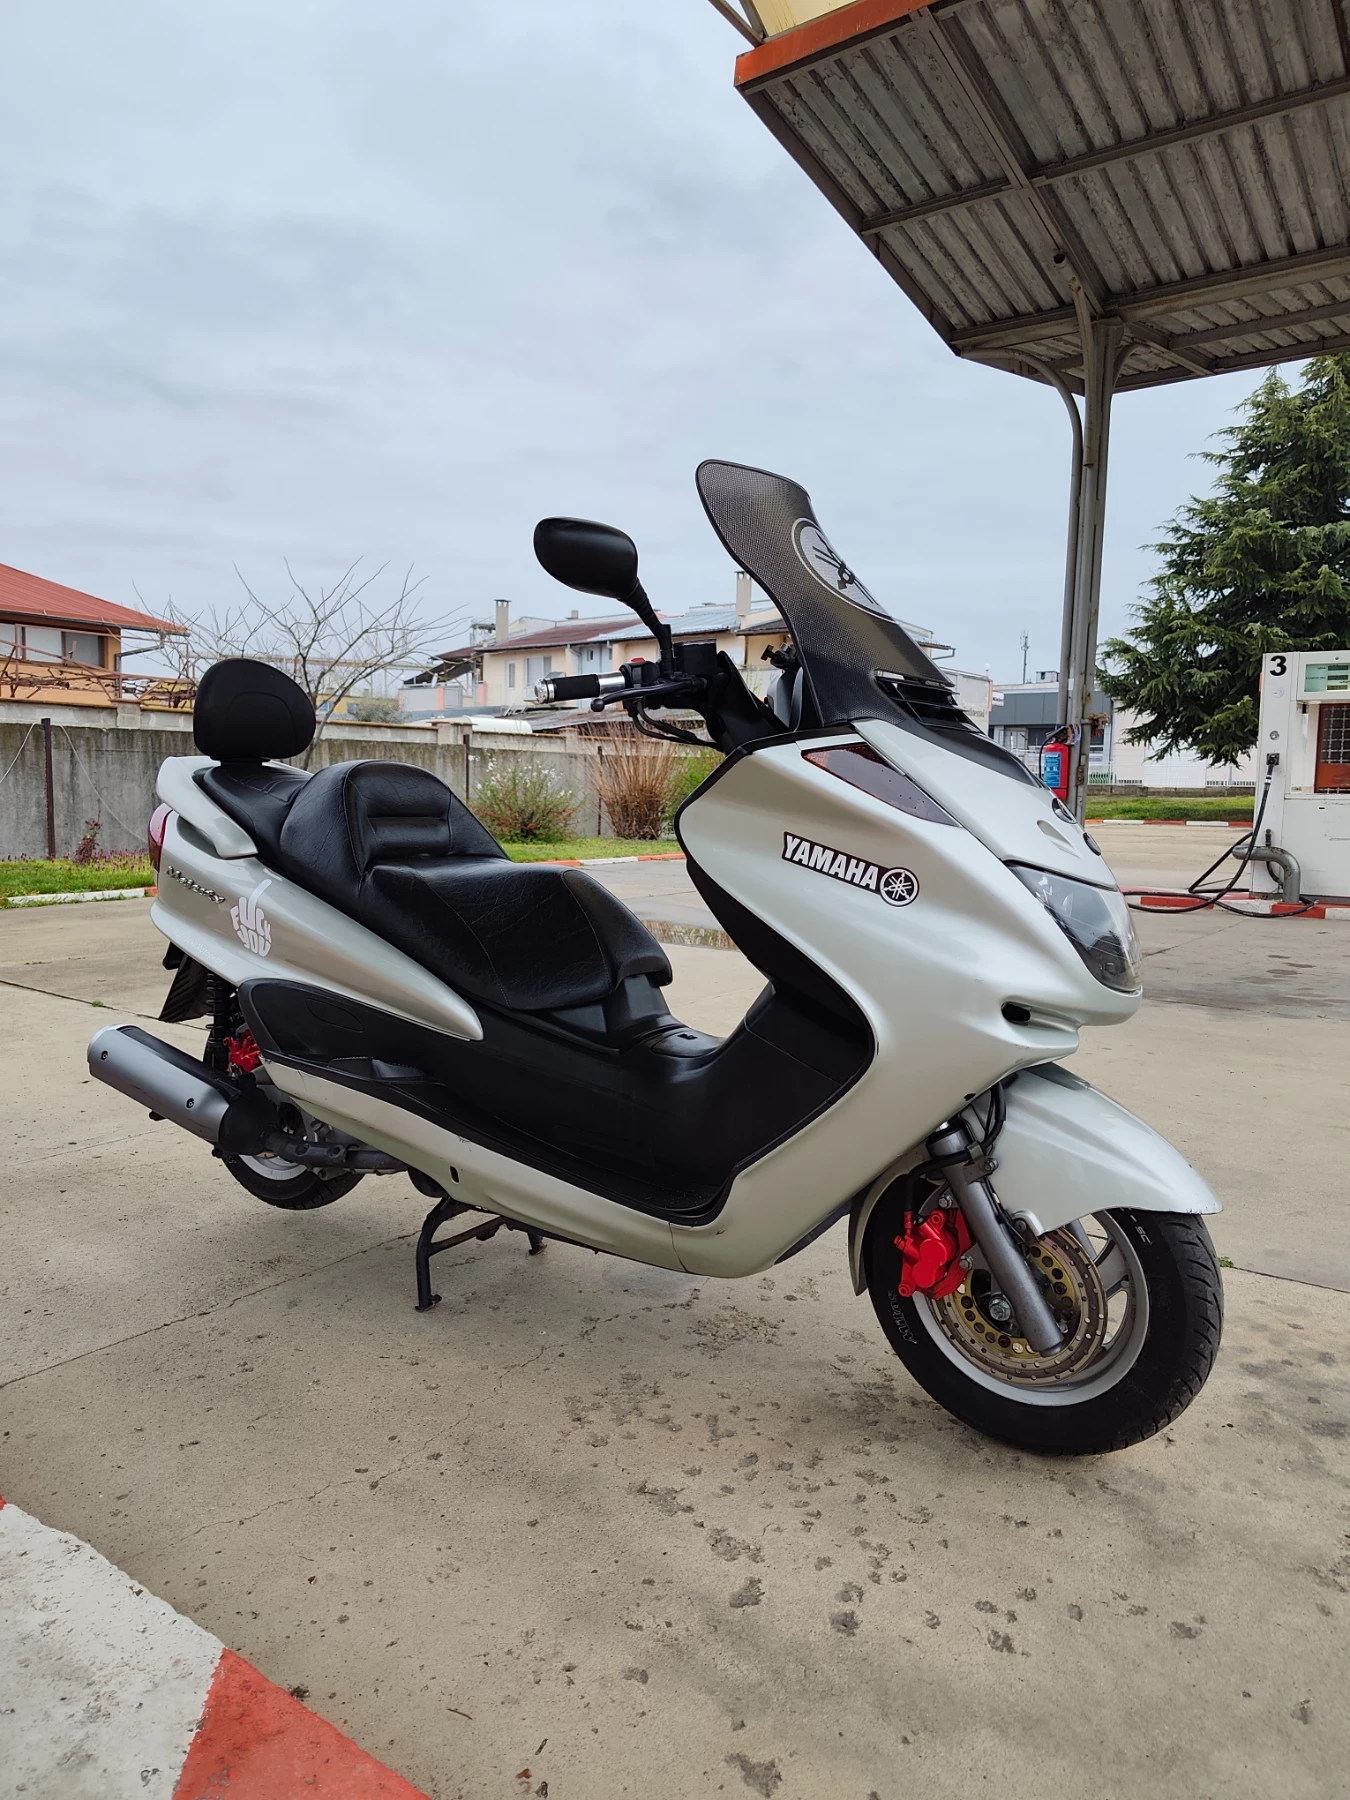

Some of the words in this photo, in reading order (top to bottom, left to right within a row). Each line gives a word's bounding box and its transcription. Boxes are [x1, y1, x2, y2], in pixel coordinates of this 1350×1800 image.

[1269, 655, 1287, 677] 3
[784, 834, 879, 890] YAMAHA
[230, 879, 272, 943] FUCK
[236, 924, 272, 957] YOU
